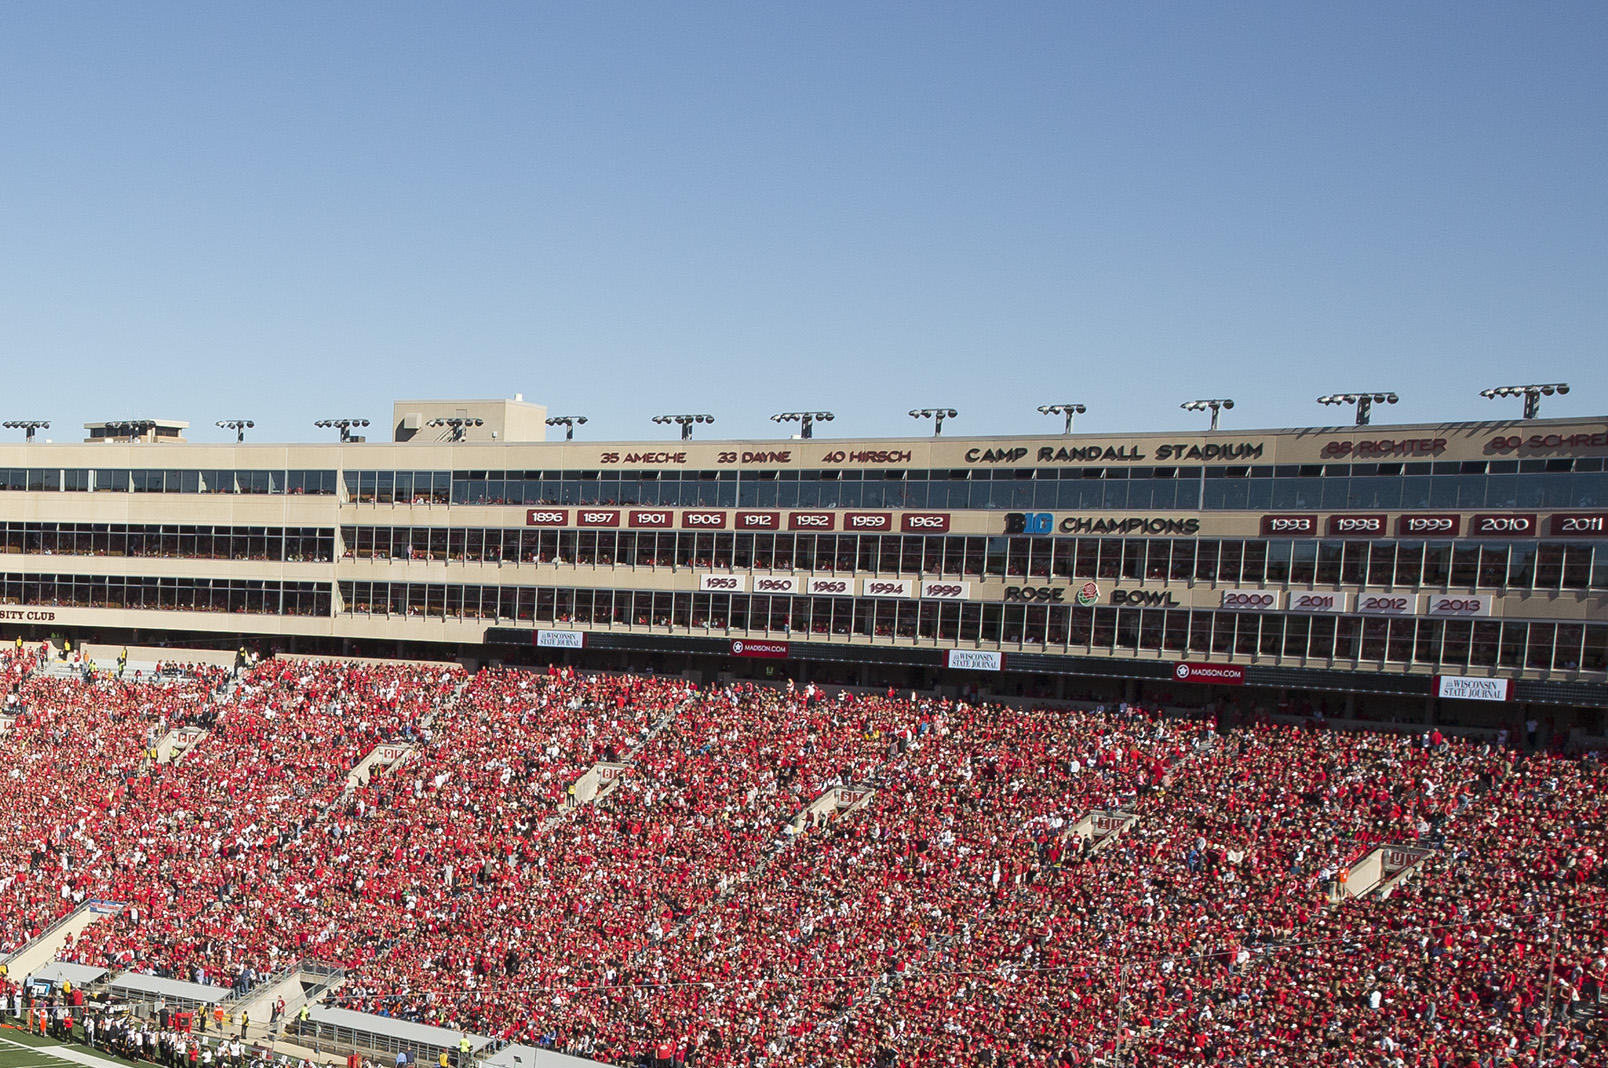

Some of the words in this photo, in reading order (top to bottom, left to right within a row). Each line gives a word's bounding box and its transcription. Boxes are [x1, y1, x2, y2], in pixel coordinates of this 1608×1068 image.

[965, 448, 1029, 463] CAMP
[1037, 446, 1146, 463] RANDALL
[1155, 442, 1264, 462] STADIUM
[1359, 438, 1448, 456] RICHTER
[600, 452, 620, 464] 35
[623, 452, 687, 464] AMECHE
[717, 452, 738, 463] 33
[741, 451, 792, 463] DAYNE
[821, 451, 846, 463] 40
[849, 450, 912, 463] HIRSCH
[532, 513, 563, 522] 1896
[584, 513, 614, 522] 1897
[637, 514, 665, 523] 1901
[688, 514, 722, 525] 1906
[744, 515, 771, 526] 1912
[796, 515, 828, 526] 1952
[852, 516, 885, 527] 1959
[909, 516, 943, 527] 1962
[1059, 517, 1200, 535] CHAMPIONS
[1270, 519, 1311, 531] 1993
[1338, 519, 1380, 531] 1998
[1408, 519, 1452, 531] 1999
[1481, 518, 1529, 531] 2010
[1562, 518, 1603, 531] 2011
[706, 578, 737, 589] 1953
[758, 580, 792, 591] 1960
[813, 581, 847, 592] 1963
[869, 582, 904, 594] 1994
[926, 584, 962, 597] 1999
[1005, 586, 1065, 602] ROSE
[1110, 590, 1180, 608] BOWL
[1225, 594, 1273, 606] 2000
[1299, 595, 1334, 608] 2011
[1365, 597, 1407, 610] 2012
[1436, 598, 1481, 611] 2013
[27, 611, 55, 621] CLUB
[1191, 669, 1241, 678] MADISON.COM
[1453, 679, 1497, 690] WISCONSIN
[1444, 688, 1469, 698] STATE
